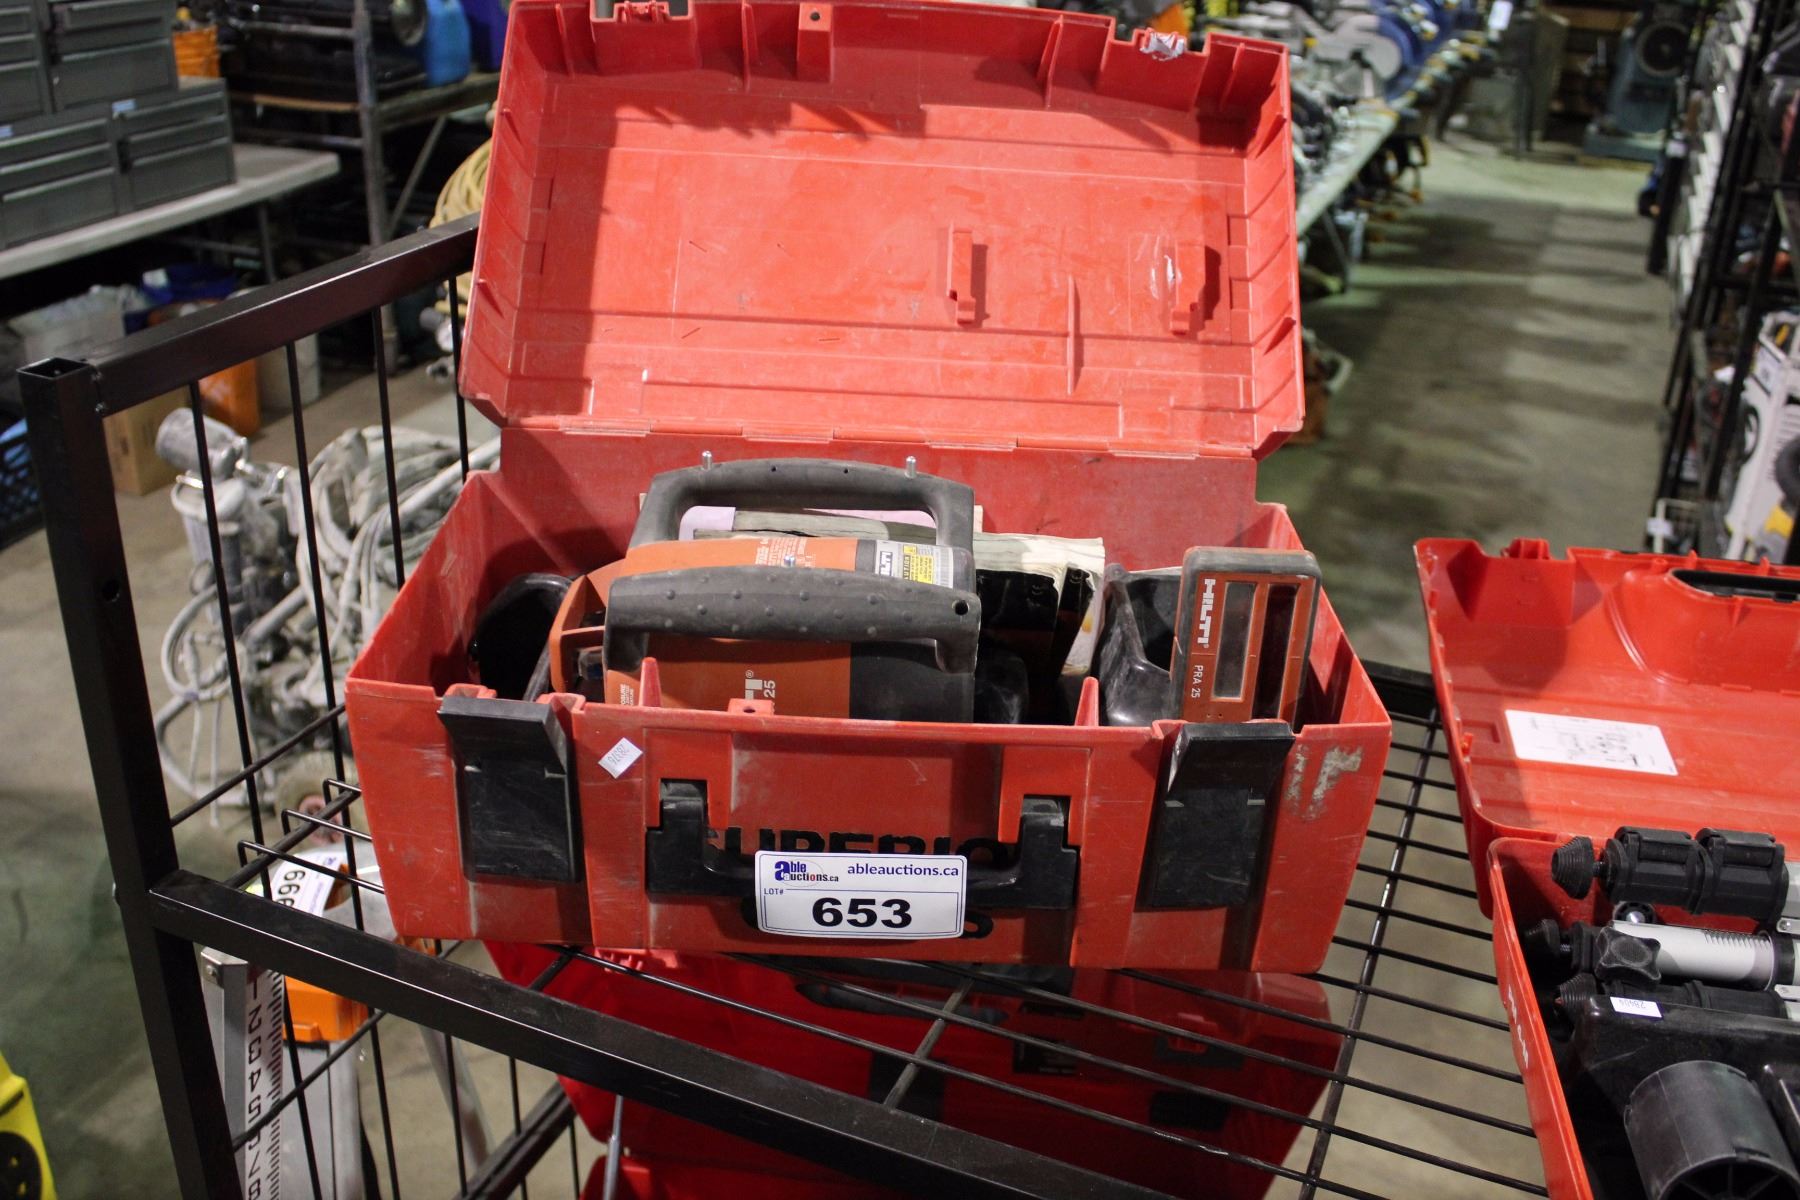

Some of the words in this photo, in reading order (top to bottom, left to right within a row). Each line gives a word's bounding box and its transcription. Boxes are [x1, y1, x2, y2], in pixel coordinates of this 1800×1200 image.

[1197, 578, 1216, 645] HILTI
[1192, 664, 1204, 685] PRA
[763, 679, 776, 699] 25
[1191, 688, 1201, 699] 25
[847, 863, 959, 876] ableauctions.ca
[812, 897, 912, 928] 653
